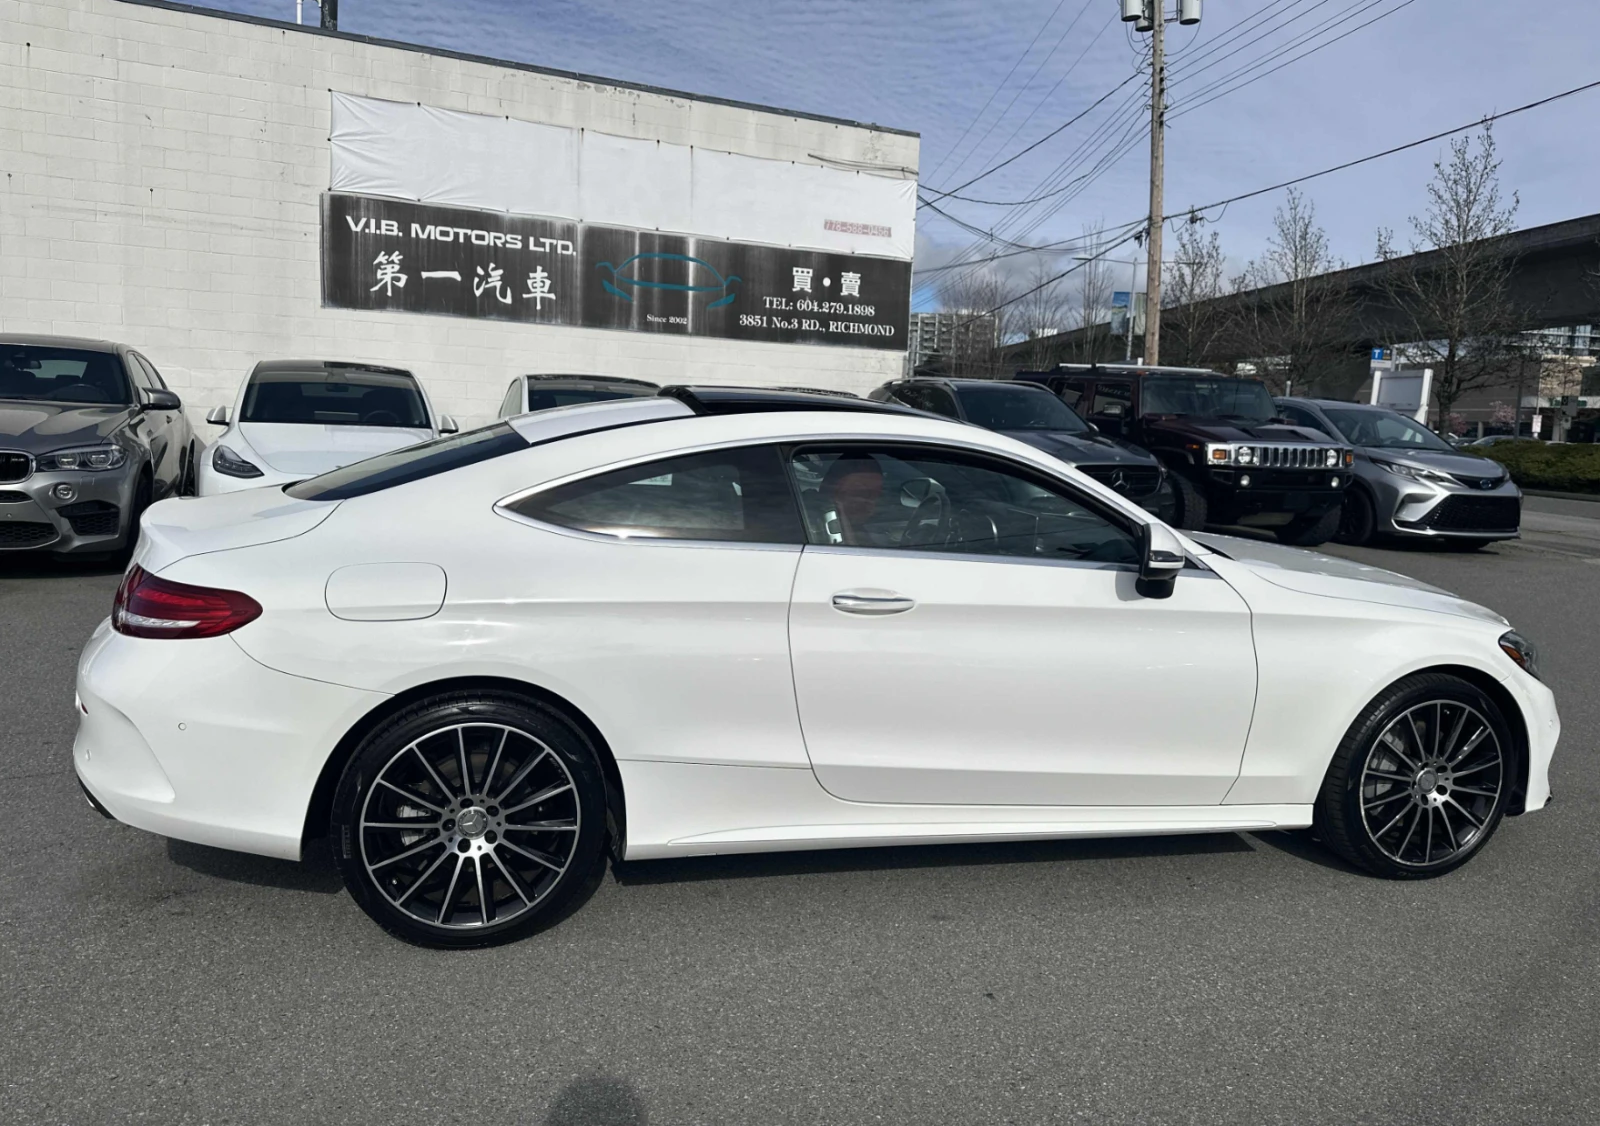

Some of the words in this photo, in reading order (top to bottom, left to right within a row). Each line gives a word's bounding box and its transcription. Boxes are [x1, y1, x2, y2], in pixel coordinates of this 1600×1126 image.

[346, 215, 403, 237] V.I.B.
[410, 223, 522, 249] MOTORS
[529, 236, 577, 256] LTD.
[370, 251, 556, 310] 第一汽車
[763, 296, 794, 310] TEL:
[796, 299, 875, 316] 604.279.1898
[646, 313, 667, 323] Since
[739, 314, 768, 328] 3851
[771, 316, 799, 330] No.3
[801, 320, 826, 333] RD.,
[828, 321, 895, 337] RICHMOND
[1373, 349, 1381, 359] T
